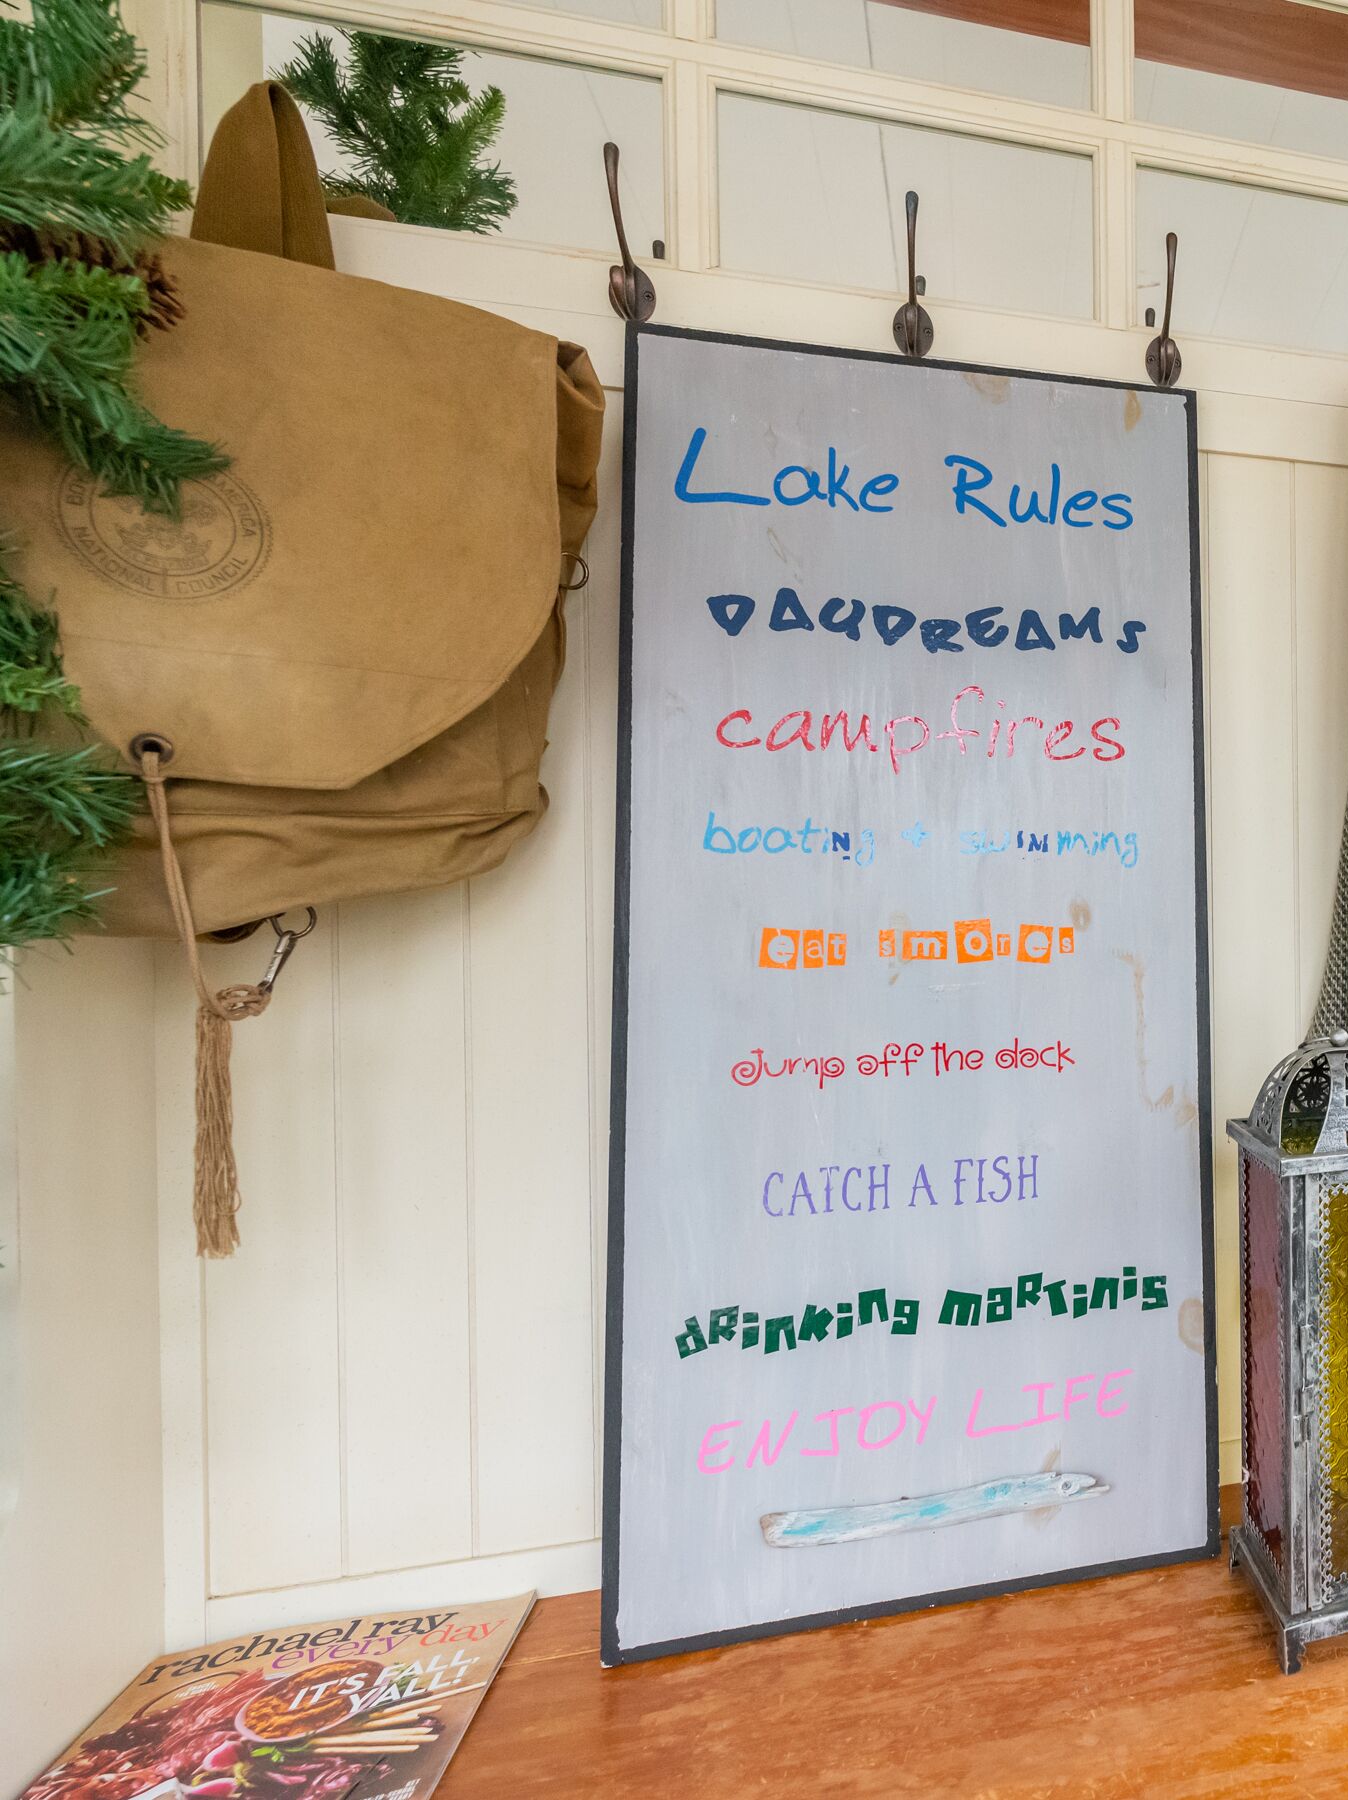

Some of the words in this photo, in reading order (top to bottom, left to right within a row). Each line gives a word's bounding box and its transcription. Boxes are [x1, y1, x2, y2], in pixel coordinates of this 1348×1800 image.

[674, 427, 899, 513] Lake
[944, 454, 1134, 530] Rules
[176, 558, 248, 594] COUNCIL
[706, 587, 1146, 654] DAYDREAMS
[715, 685, 1126, 775] campfires
[758, 927, 847, 970] eat
[879, 918, 1074, 964] smores
[731, 1047, 844, 1089] Jump
[857, 1042, 923, 1077] off
[931, 1040, 983, 1076] the
[995, 1038, 1075, 1071] dock
[762, 1165, 889, 1217] CATCH
[910, 1163, 938, 1208] A
[954, 1154, 1039, 1206] FISH
[697, 1396, 936, 1474] ENJOY
[965, 1369, 1133, 1437] LIFE
[140, 1620, 362, 1687] rachael
[370, 1612, 459, 1635] ray
[272, 1631, 409, 1670] every
[419, 1618, 509, 1646] day
[288, 1672, 369, 1711] IT'S
[374, 1649, 480, 1688] FALL,
